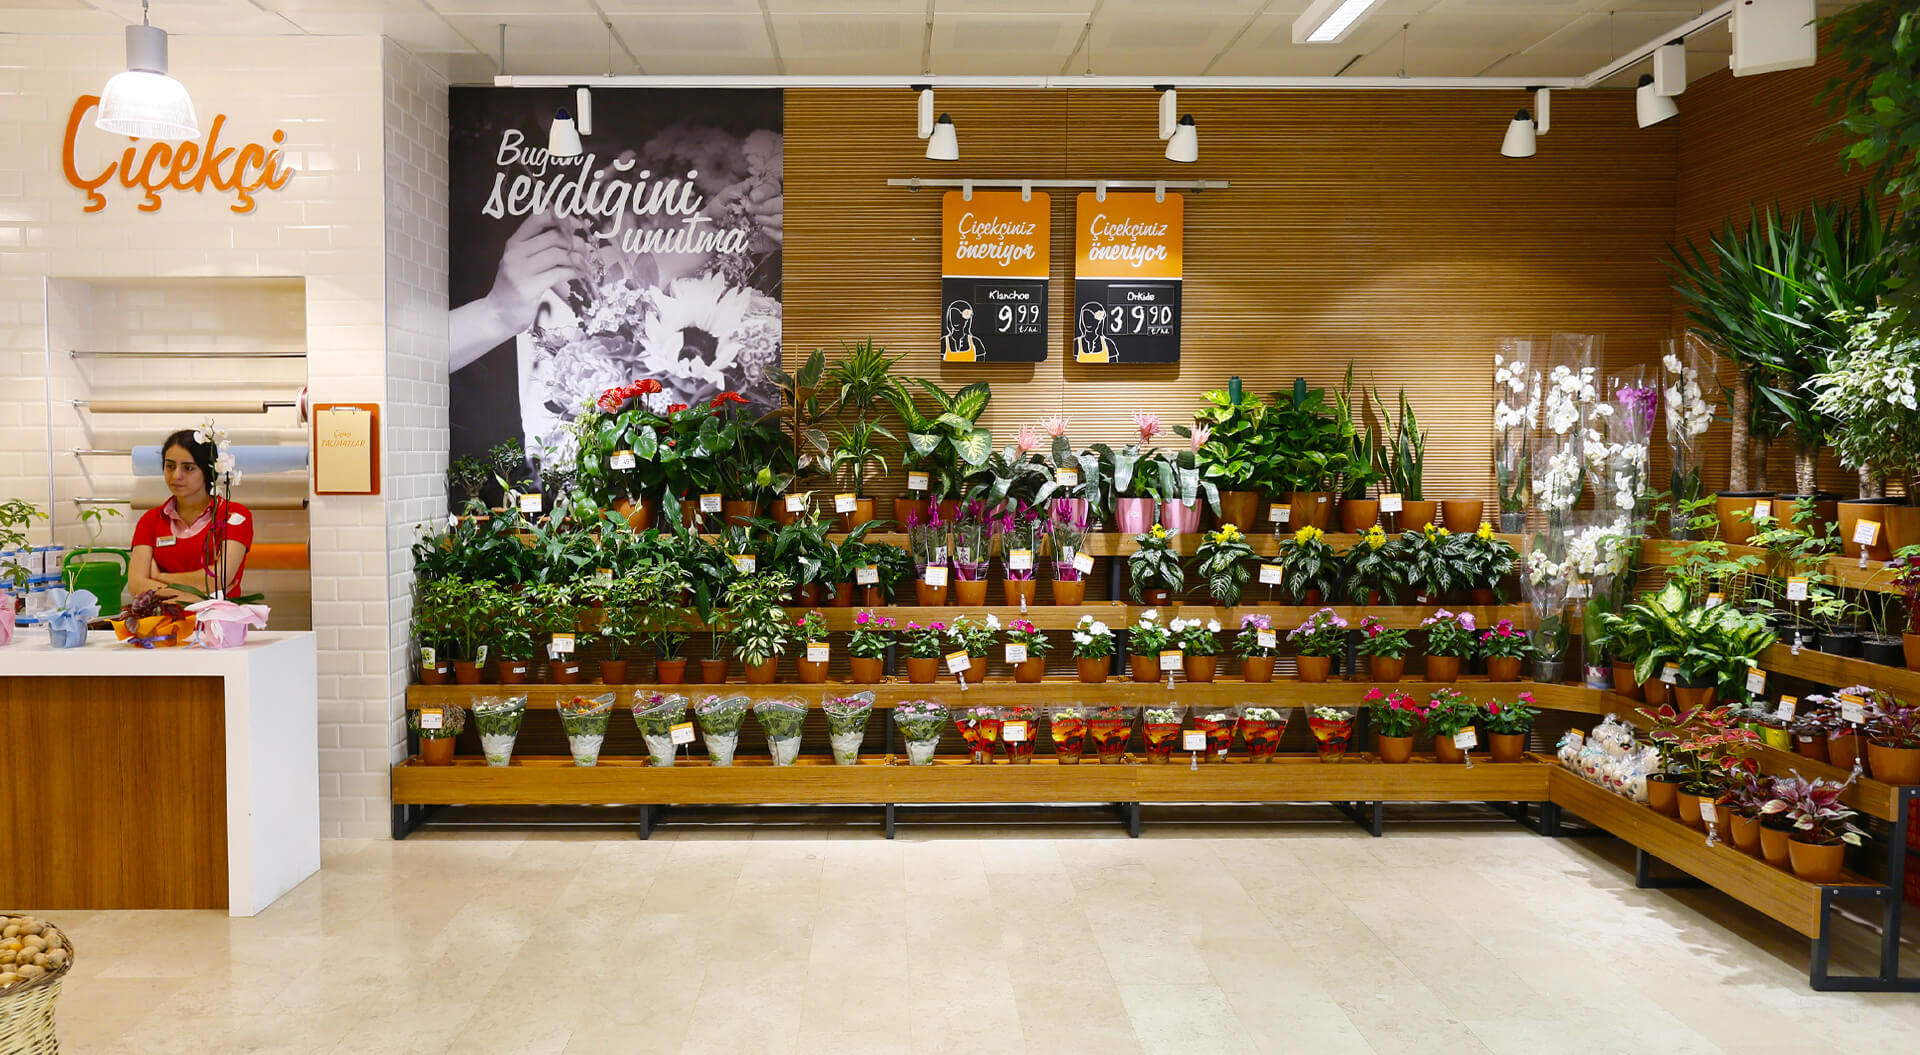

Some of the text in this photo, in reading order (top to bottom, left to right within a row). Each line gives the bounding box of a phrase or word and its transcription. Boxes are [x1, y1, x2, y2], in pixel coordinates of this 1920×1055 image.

[62, 94, 294, 213] Çiçekçi
[482, 153, 703, 238] sevdiğini
[622, 212, 749, 254] unutma
[958, 212, 1036, 240] Çiçekçiniz
[1090, 213, 1168, 241] Çiçekçiniz
[956, 241, 1036, 267] öneriyor
[1088, 242, 1168, 268] öneriyor
